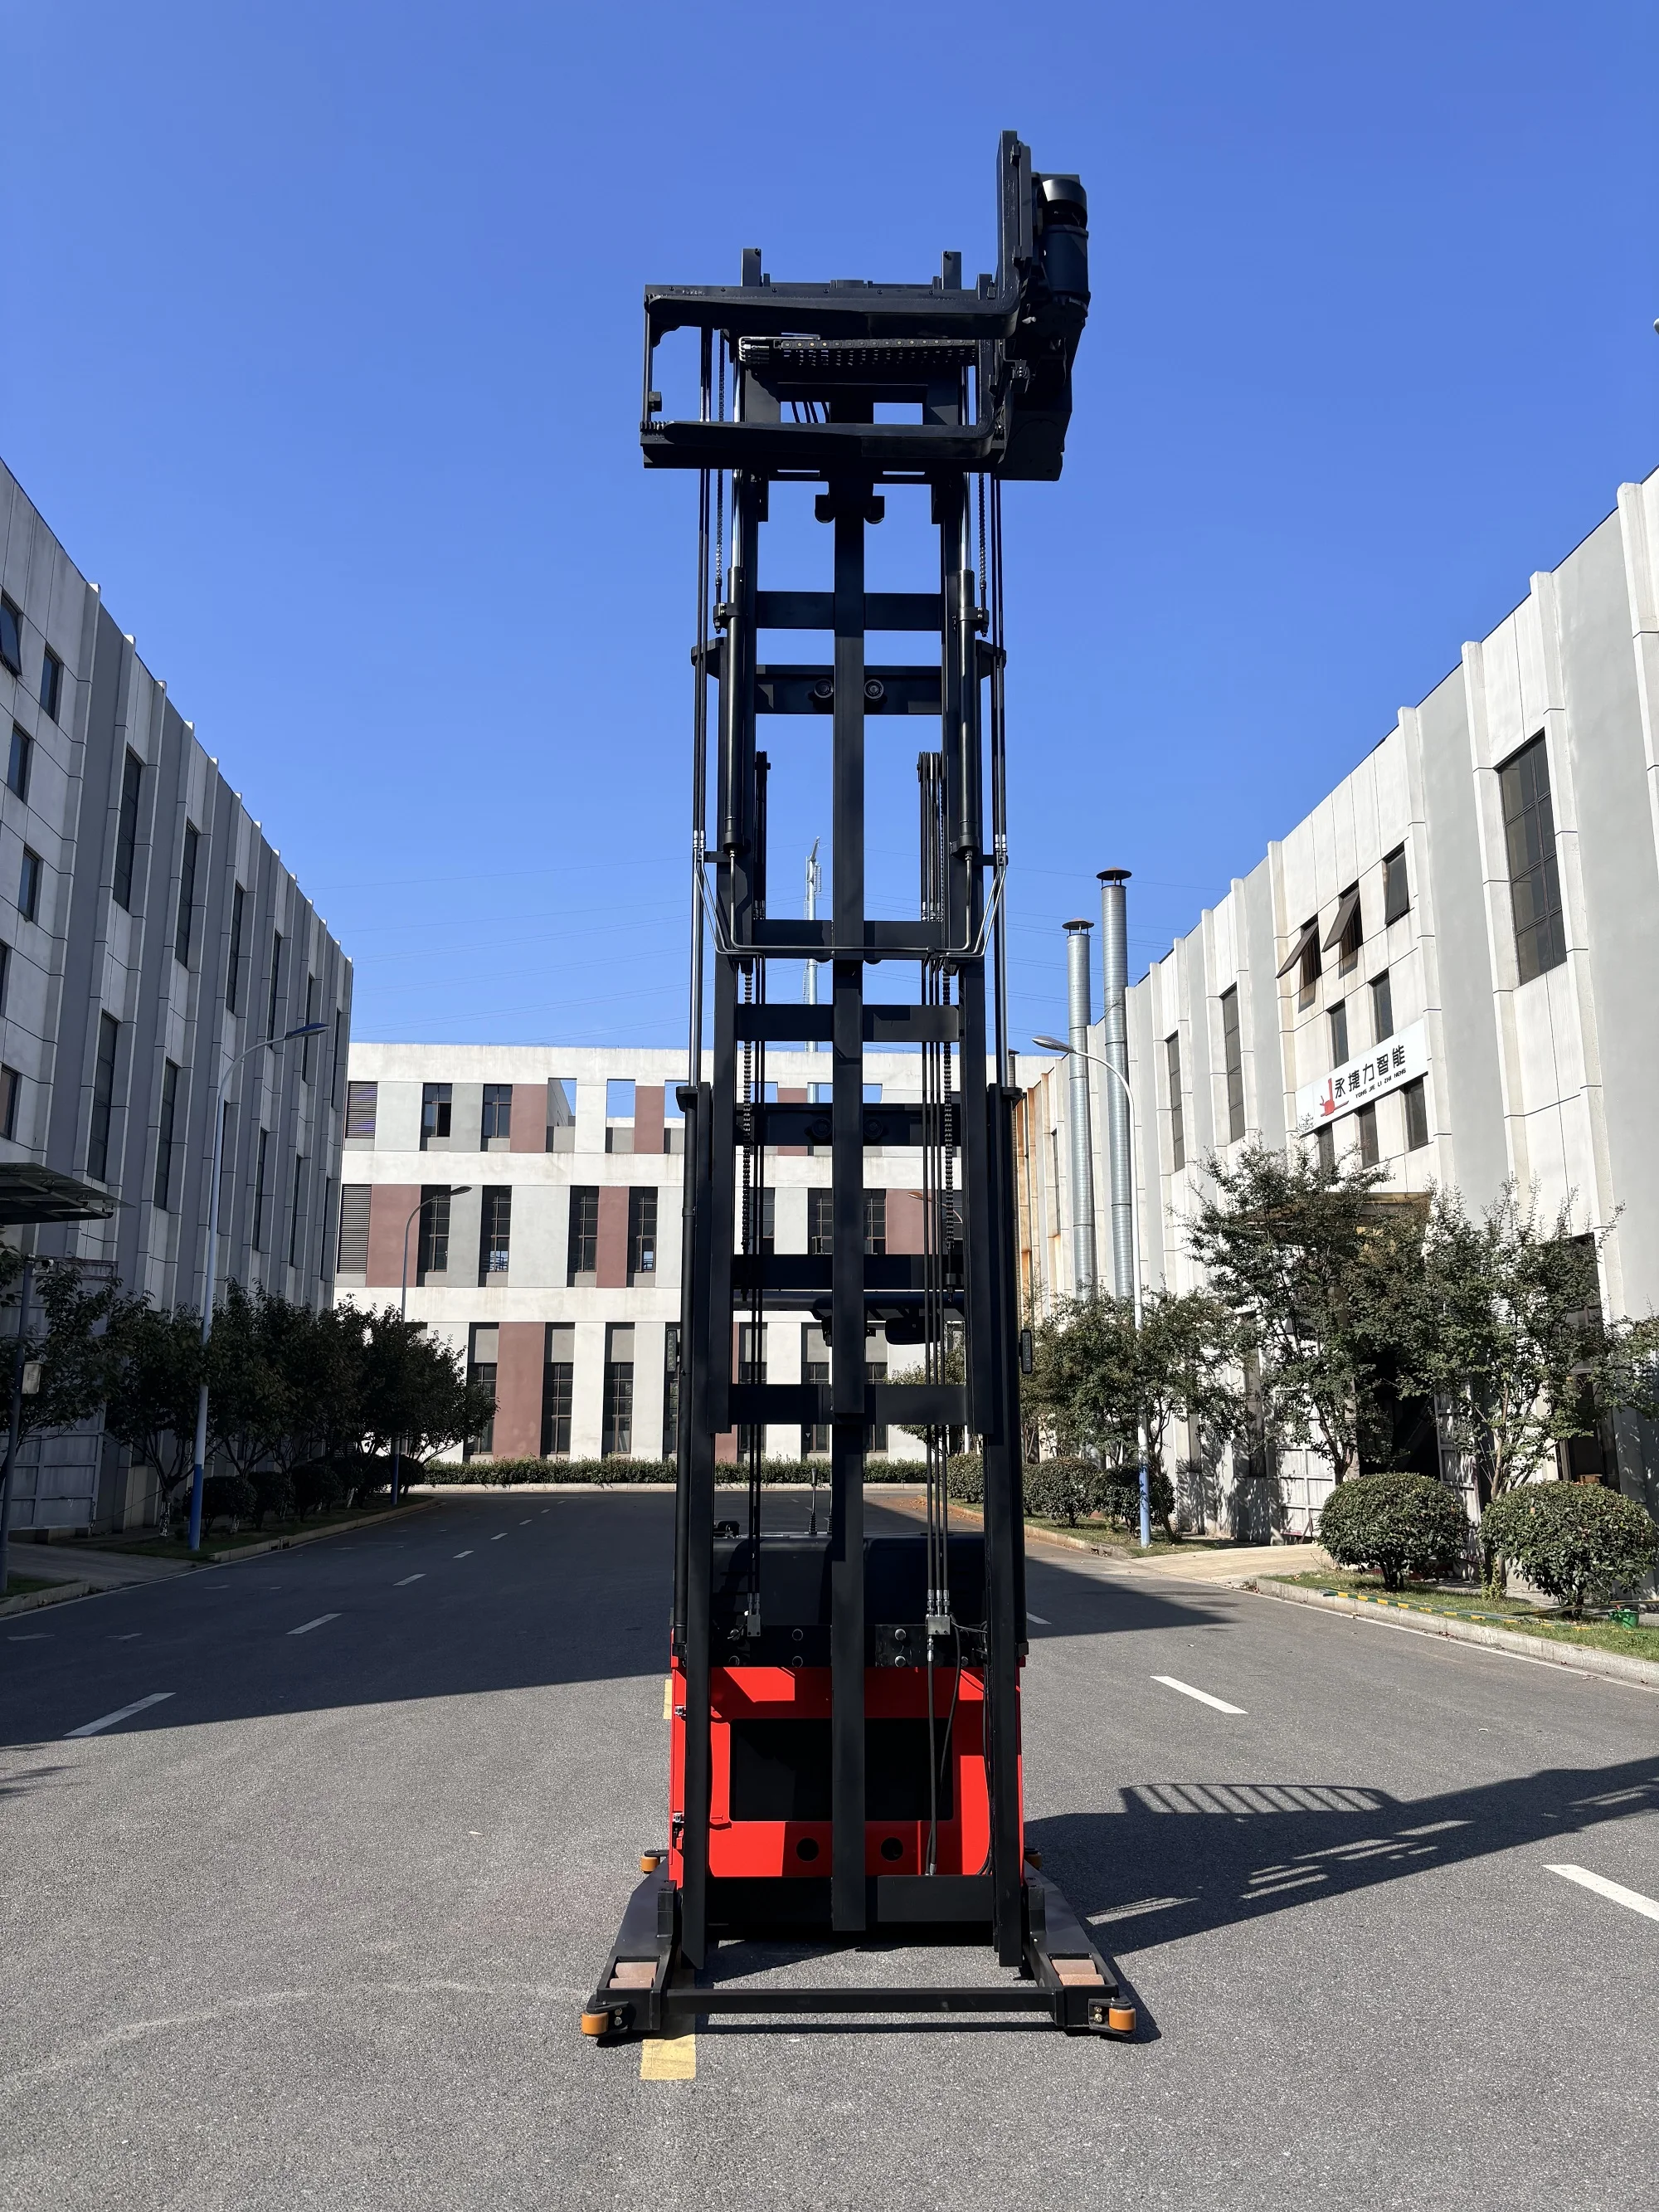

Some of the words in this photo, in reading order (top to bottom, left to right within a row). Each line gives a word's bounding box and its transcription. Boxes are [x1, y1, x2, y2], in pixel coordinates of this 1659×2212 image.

[1335, 1045, 1406, 1099] 永捷力智能
[1355, 1089, 1367, 1098] YONG
